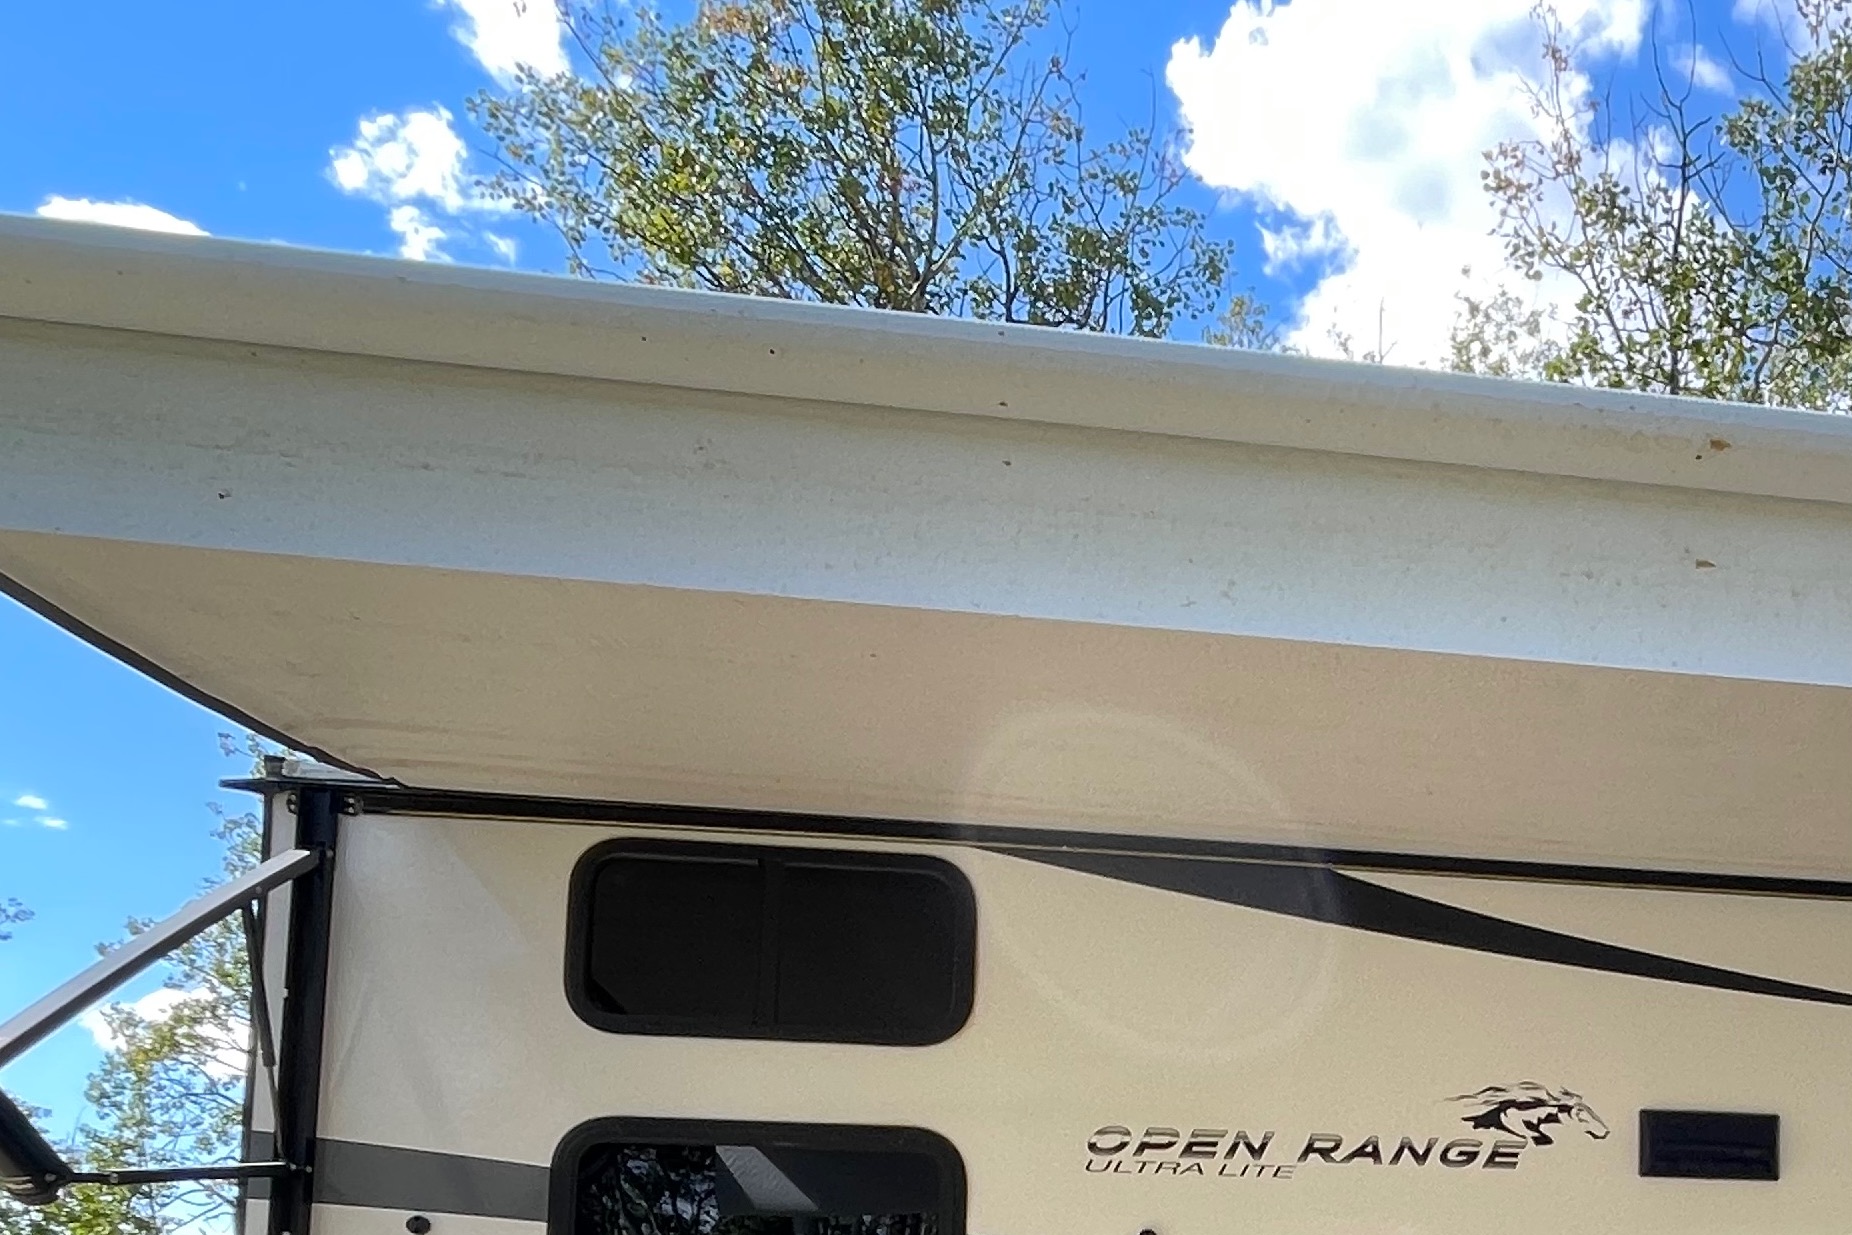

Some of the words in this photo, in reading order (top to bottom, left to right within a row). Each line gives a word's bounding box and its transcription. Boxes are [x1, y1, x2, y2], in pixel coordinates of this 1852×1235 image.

[1086, 1126, 1276, 1161] OPEN
[1297, 1133, 1529, 1170] RANGE
[1085, 1158, 1205, 1176] ULTRA
[1217, 1163, 1297, 1180] LITE
